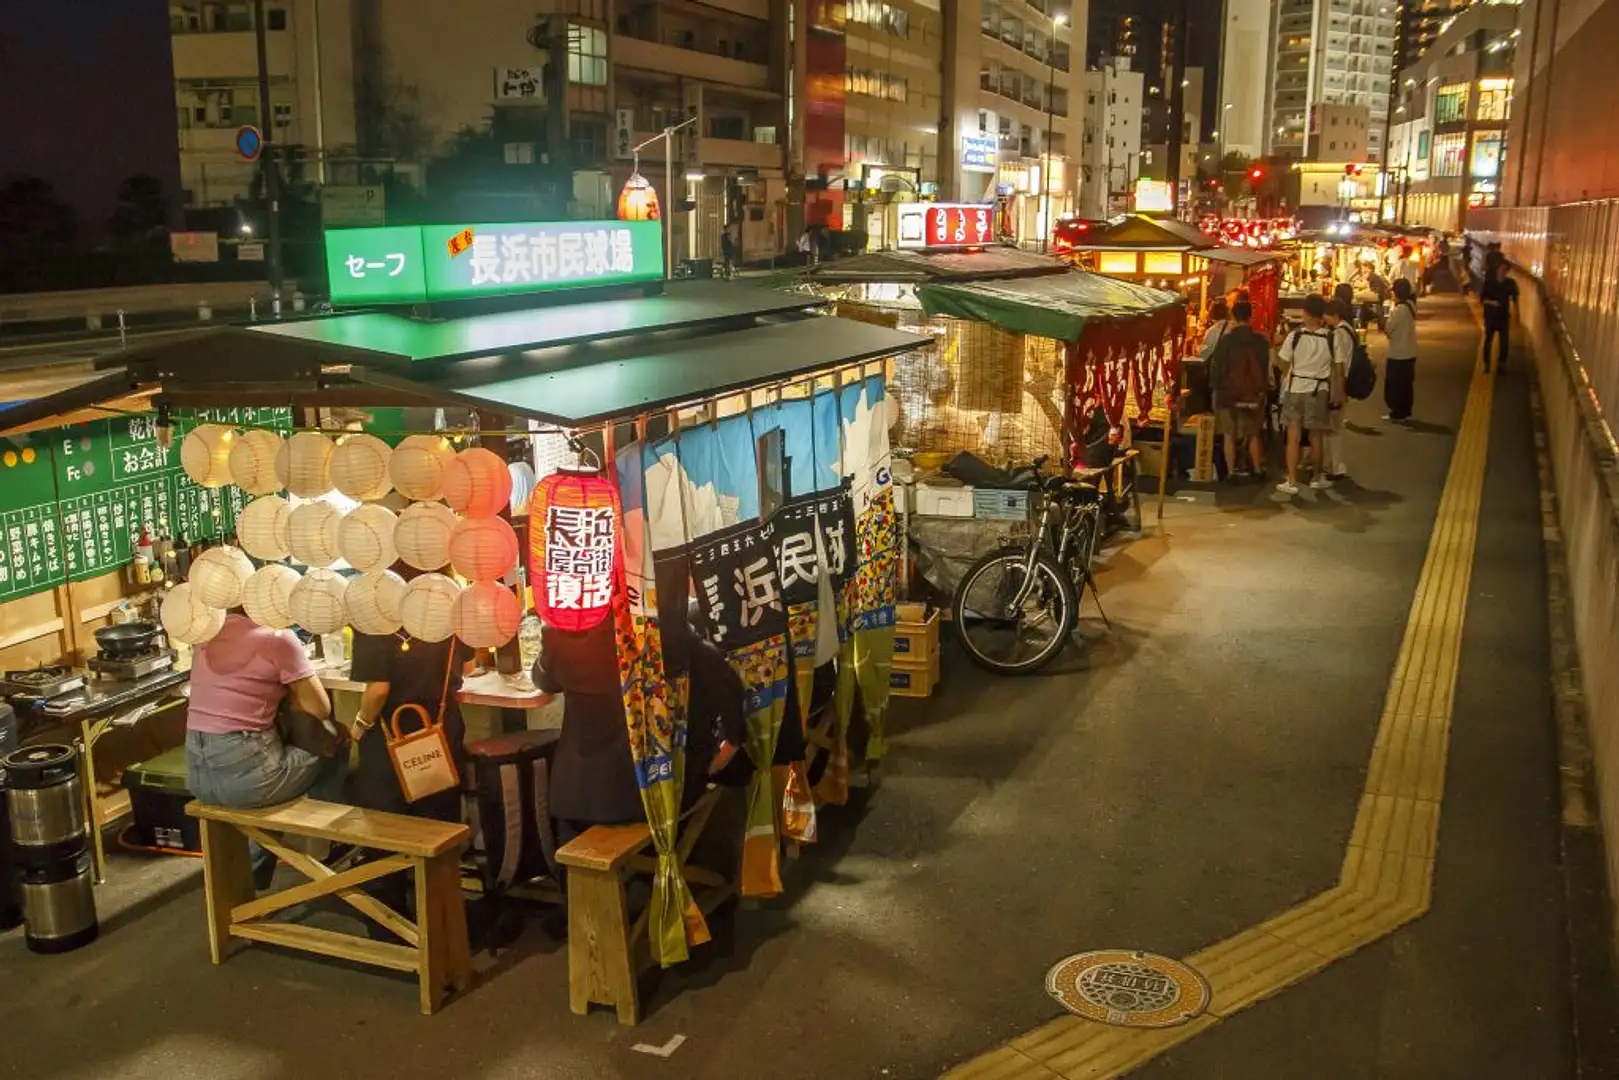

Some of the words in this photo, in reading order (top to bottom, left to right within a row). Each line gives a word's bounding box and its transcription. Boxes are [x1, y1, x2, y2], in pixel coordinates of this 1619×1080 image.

[344, 253, 406, 279] セーフ
[470, 229, 634, 286] 長浜市民球場
[123, 446, 170, 474] お会計
[546, 507, 613, 548] 長浜
[546, 574, 613, 609] 復活
